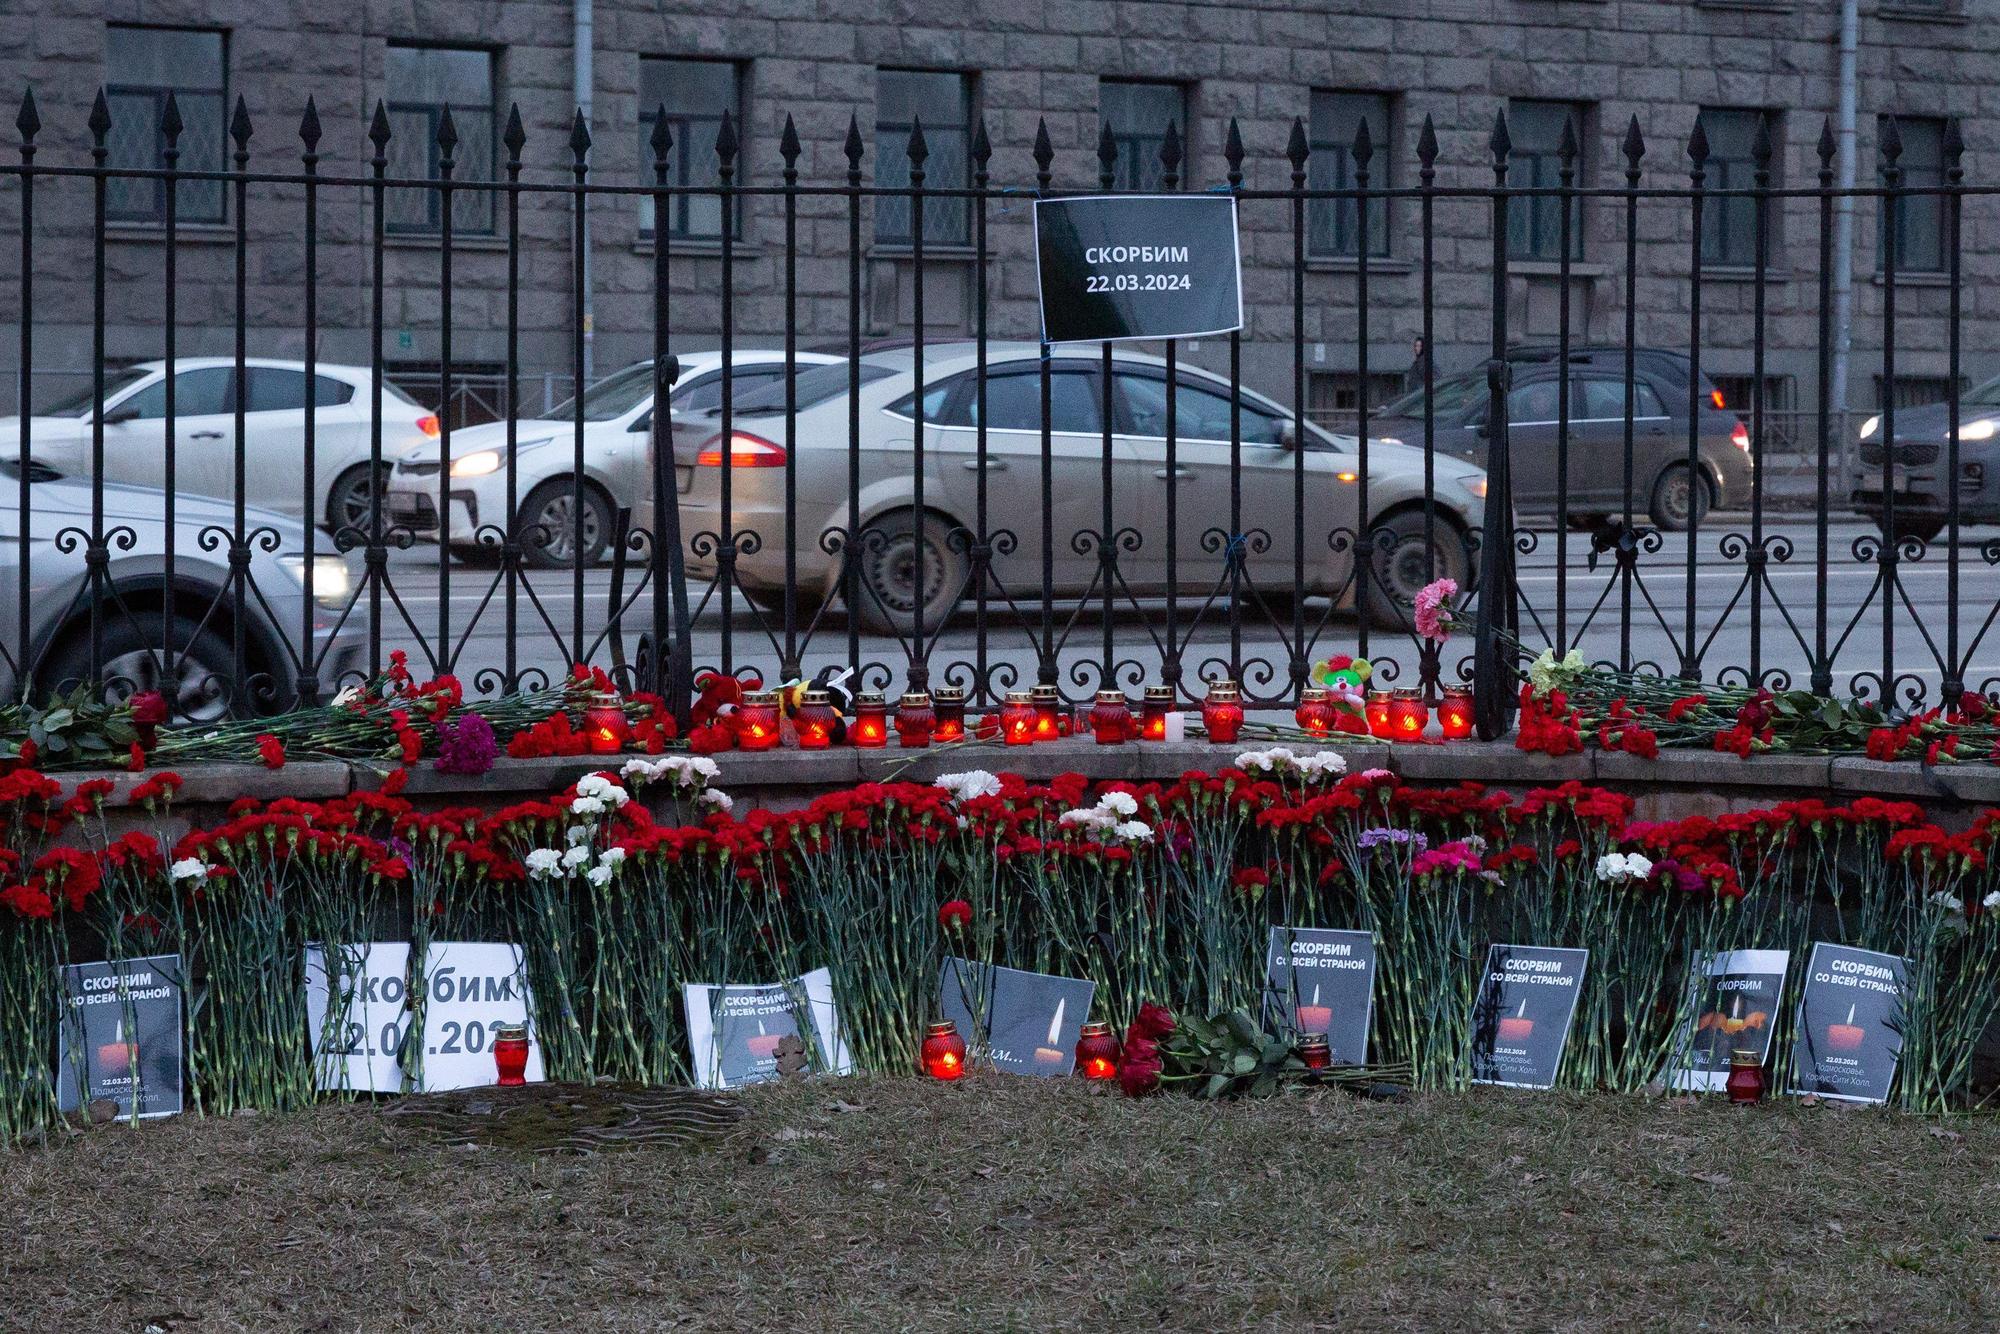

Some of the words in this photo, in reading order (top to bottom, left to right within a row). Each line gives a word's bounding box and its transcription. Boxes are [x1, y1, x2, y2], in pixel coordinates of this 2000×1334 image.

[1085, 246, 1189, 264] СКОРБИМ
[1086, 274, 1191, 293] 22.03.2024
[1290, 941, 1351, 956] СКОРБИМ
[1291, 956, 1317, 967] ВСЕЙ
[1319, 958, 1366, 970] СТРАНОЙ
[1505, 959, 1562, 973] СКОРБИМ
[1831, 959, 1893, 981] СКОРБИМ
[1490, 972, 1504, 982] СО
[1505, 973, 1530, 984] ВСЕЙ
[1530, 975, 1574, 987] СТРАНОЙ
[1716, 980, 1762, 991] СКОРБИМ
[1815, 972, 1830, 983] СО
[1831, 974, 1858, 987] ВСЕЙ
[86, 991, 116, 1005] ВСЕЙ
[725, 992, 786, 1006] СКОРБИМ
[730, 1006, 756, 1017] ВСЕЙ
[1495, 1047, 1527, 1056] 22.03.2024
[1826, 1056, 1858, 1066] 22.03.2024
